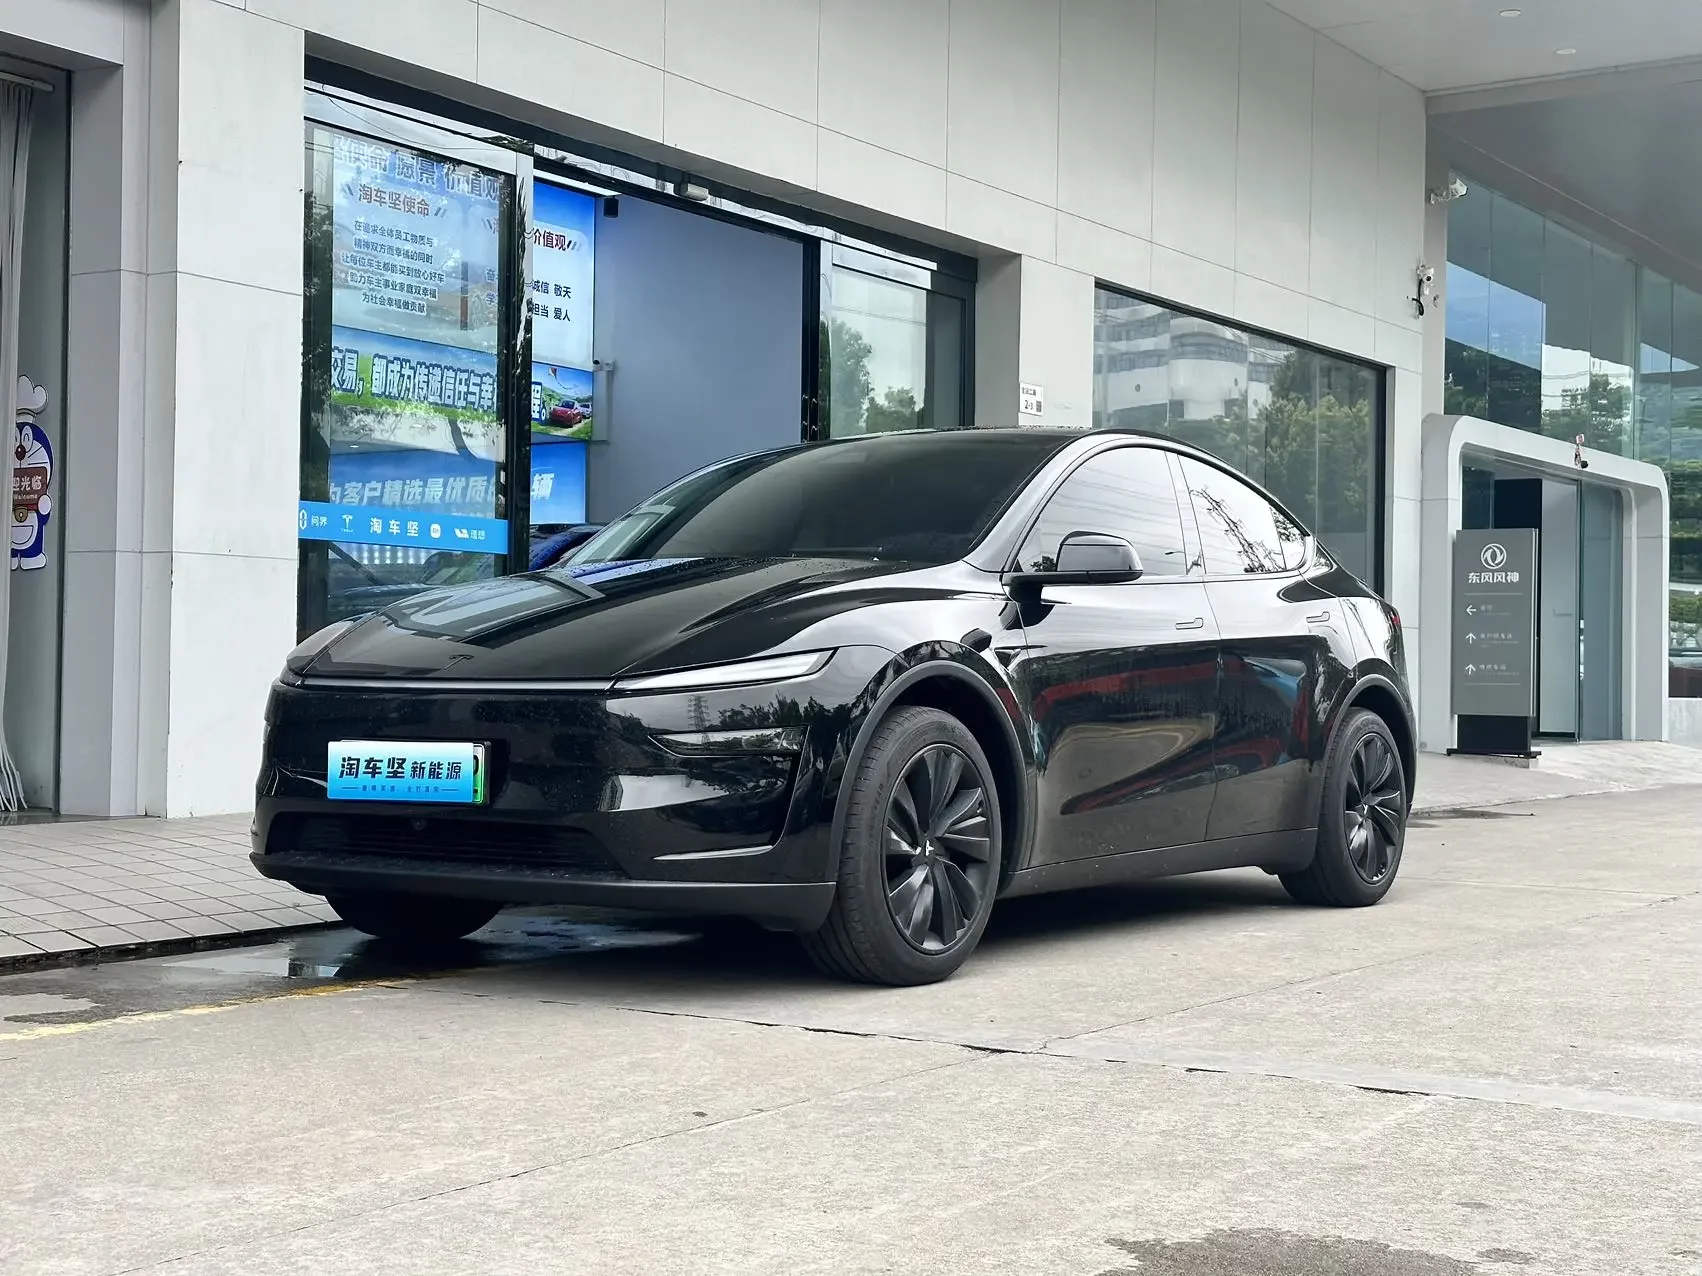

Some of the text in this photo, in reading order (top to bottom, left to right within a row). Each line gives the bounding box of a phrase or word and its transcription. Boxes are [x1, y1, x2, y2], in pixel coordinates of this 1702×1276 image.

[359, 184, 430, 218] 淘车坚使命
[532, 228, 567, 252] 价值观
[554, 283, 571, 299] 敬天
[554, 307, 571, 322] 爱人
[331, 348, 497, 411] 交易，都成为传递信任与幸
[311, 515, 328, 527] 问界
[370, 517, 419, 537] 淘车坚
[470, 529, 486, 540] 理想
[1468, 572, 1519, 584] 东风风神
[339, 756, 407, 779] 淘车坚
[410, 761, 462, 780] 新能源
